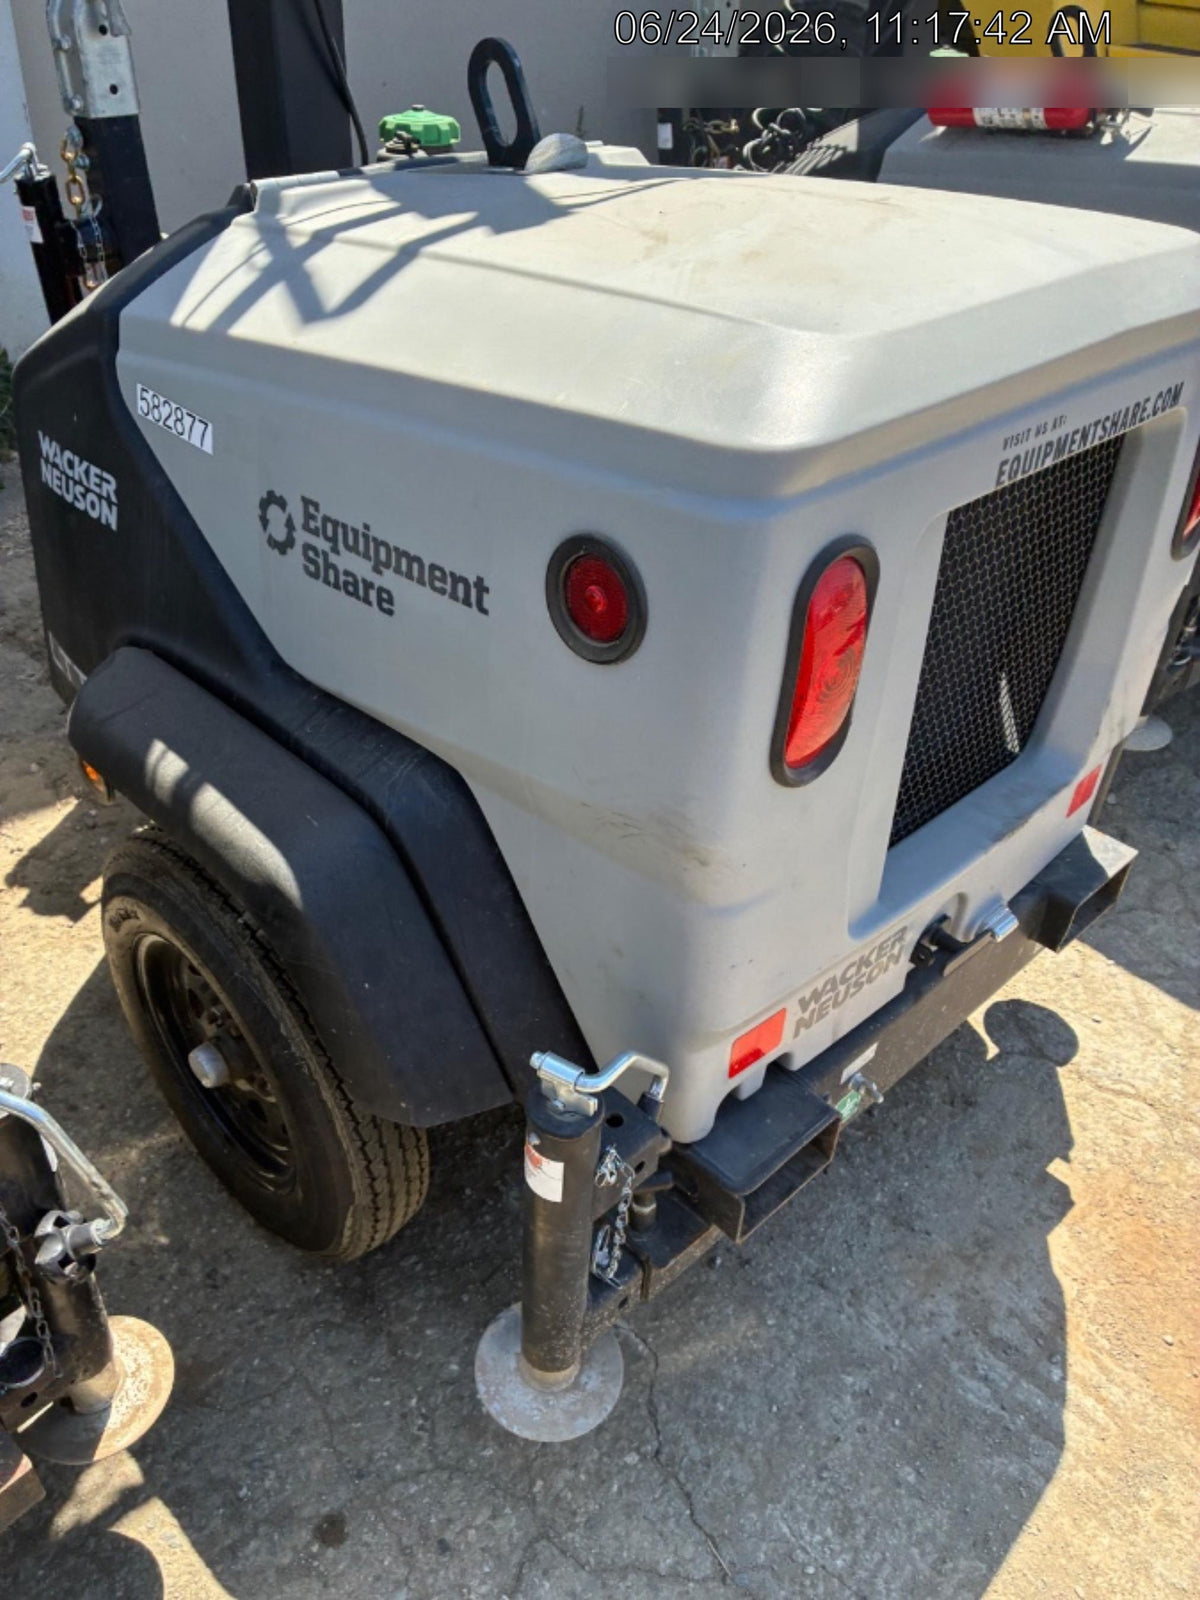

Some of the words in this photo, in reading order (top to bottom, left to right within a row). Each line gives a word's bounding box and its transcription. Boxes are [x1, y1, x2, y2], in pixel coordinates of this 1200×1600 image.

[139, 386, 209, 448] 582877
[995, 380, 1185, 487] EQUIPMENTSHARE.COM
[1003, 427, 1032, 450] VISIT
[1034, 420, 1048, 438] US
[37, 429, 119, 504] WACKER
[40, 457, 119, 532] NEUSON
[301, 495, 490, 617] Equipment
[301, 542, 395, 617] Share
[792, 942, 904, 1040] NEUSON
[798, 925, 908, 1014] WACKER
